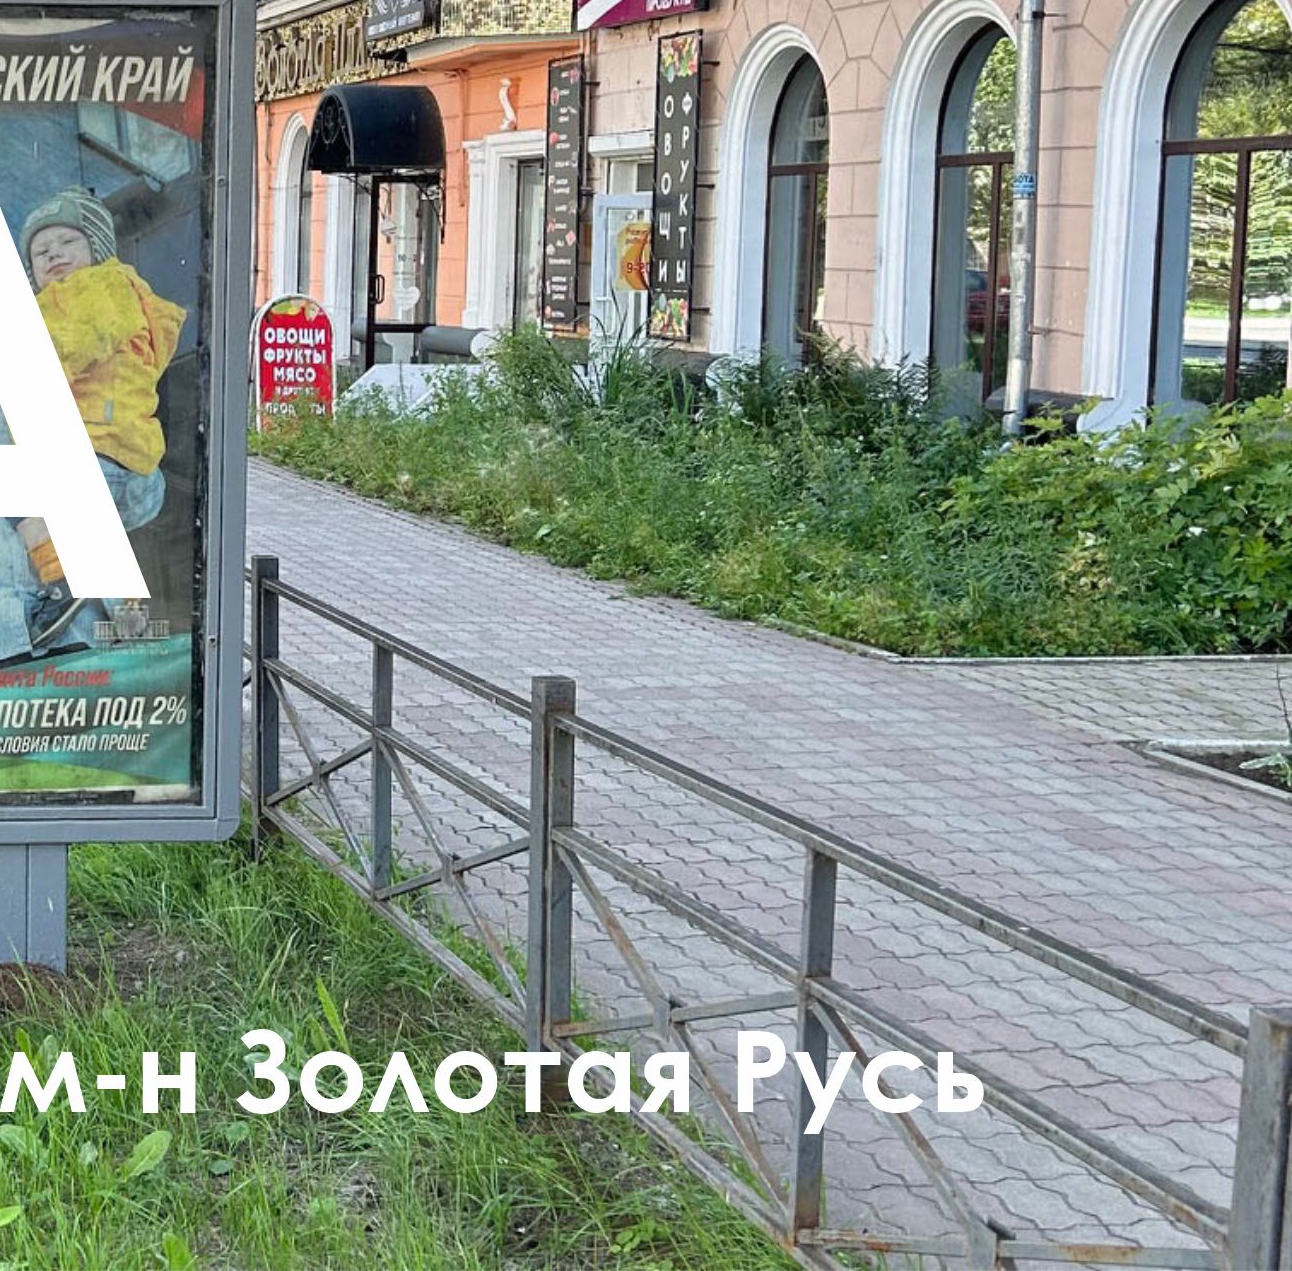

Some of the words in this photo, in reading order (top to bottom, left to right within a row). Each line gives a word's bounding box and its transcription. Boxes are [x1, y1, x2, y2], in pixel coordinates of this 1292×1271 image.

[91, 44, 196, 103] КРАЙ
[658, 94, 675, 283] ОВОЩИ
[676, 91, 693, 284] ФРУКТЫ
[264, 327, 326, 346] ОВОЩИ
[263, 348, 326, 364] ФРУКТЫ
[273, 366, 317, 382] МЯСО
[265, 402, 326, 416] ПРОДТЫ
[92, 696, 146, 730] ПОД
[149, 695, 187, 726] 2%
[52, 734, 96, 752] СТАЛО
[99, 733, 150, 752] ПРОЩЕ
